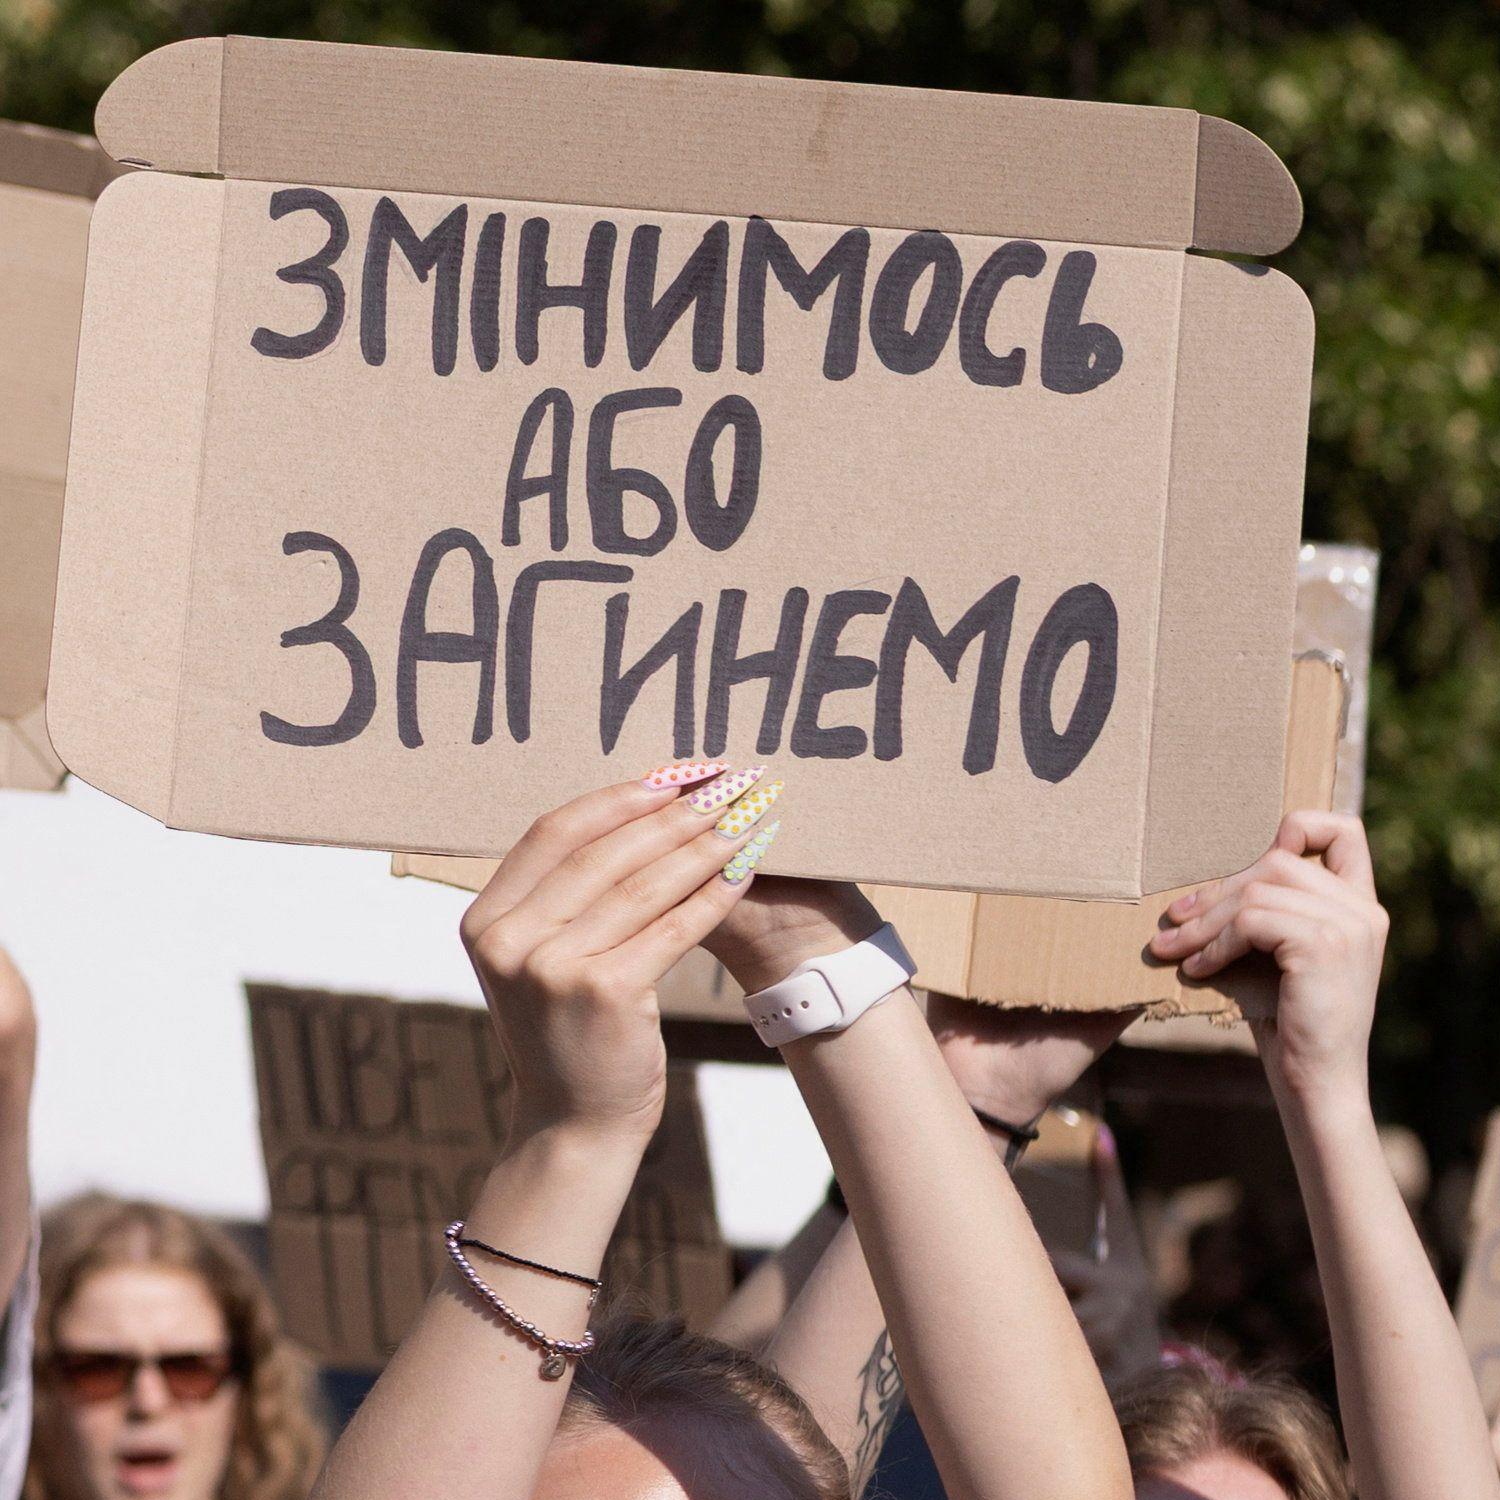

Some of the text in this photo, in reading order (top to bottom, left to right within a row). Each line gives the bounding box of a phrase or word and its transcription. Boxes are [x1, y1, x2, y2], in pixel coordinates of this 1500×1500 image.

[249, 187, 1125, 396] ЗМІНИМОСЬ
[501, 386, 762, 556] АБО
[259, 527, 1120, 785] ЗАГИНЕМО
